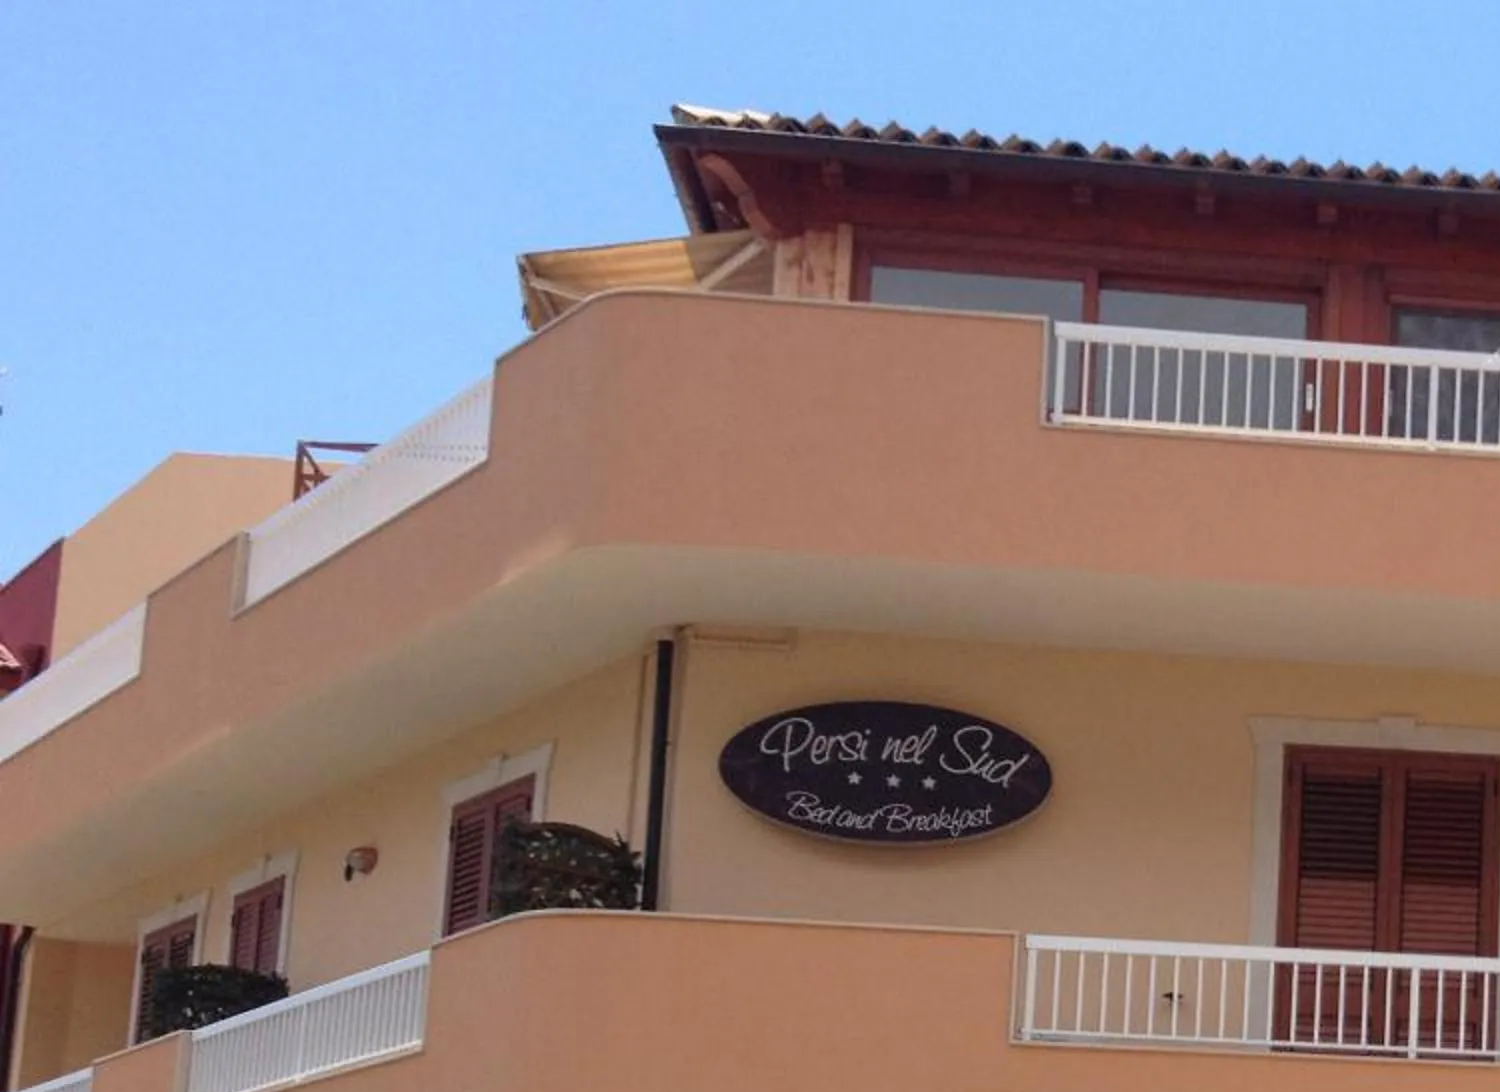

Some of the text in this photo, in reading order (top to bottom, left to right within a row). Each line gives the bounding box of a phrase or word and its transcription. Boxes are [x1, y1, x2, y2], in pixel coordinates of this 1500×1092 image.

[760, 717, 1030, 788] Persi nel Sud
[786, 791, 992, 837] Bed and Breakfast
